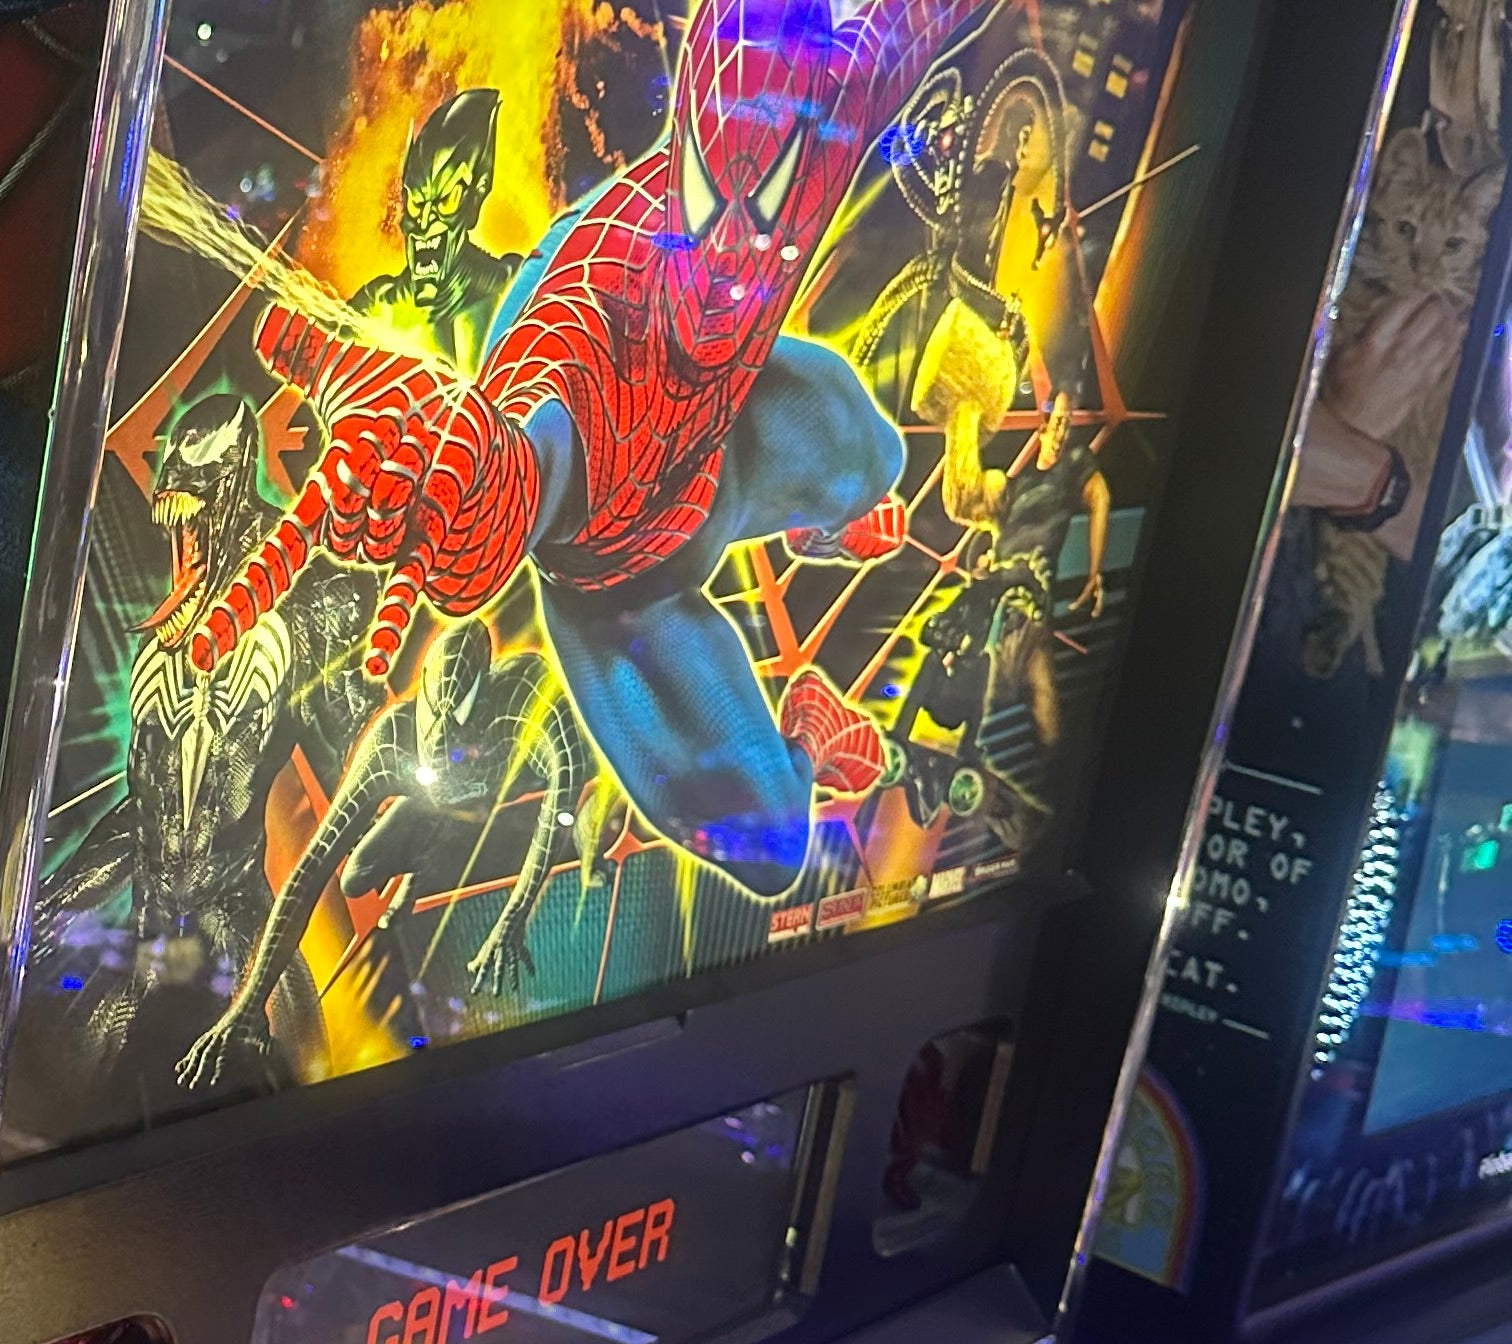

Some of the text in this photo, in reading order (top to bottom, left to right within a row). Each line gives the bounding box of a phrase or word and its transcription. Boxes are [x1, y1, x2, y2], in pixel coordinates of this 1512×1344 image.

[1269, 851, 1314, 885] OF
[771, 906, 810, 932] STERN
[538, 1197, 676, 1307] OVER
